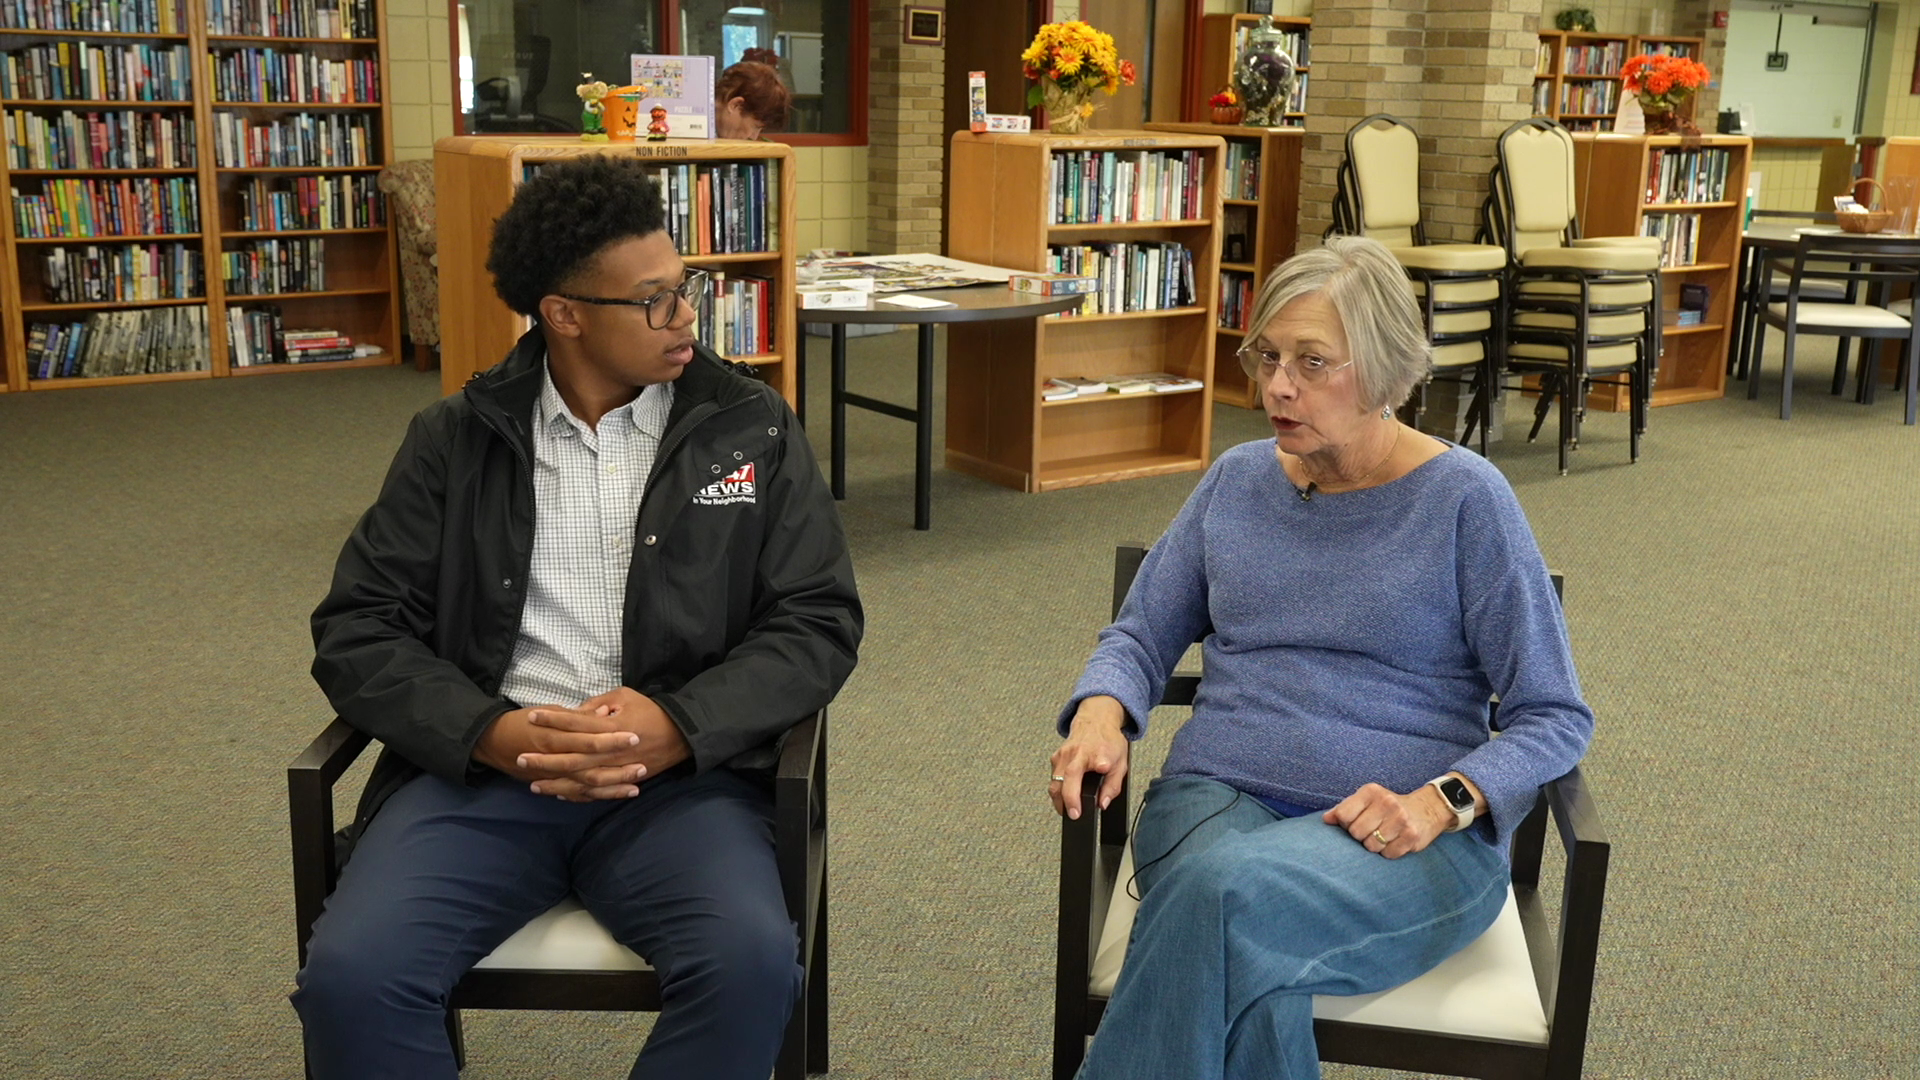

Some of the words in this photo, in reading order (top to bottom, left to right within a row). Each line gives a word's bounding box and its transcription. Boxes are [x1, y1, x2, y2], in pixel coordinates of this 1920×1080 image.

[636, 146, 653, 157] NON
[656, 146, 688, 157] FICTION
[699, 497, 713, 505] Your
[713, 496, 756, 505] Neighborhood
